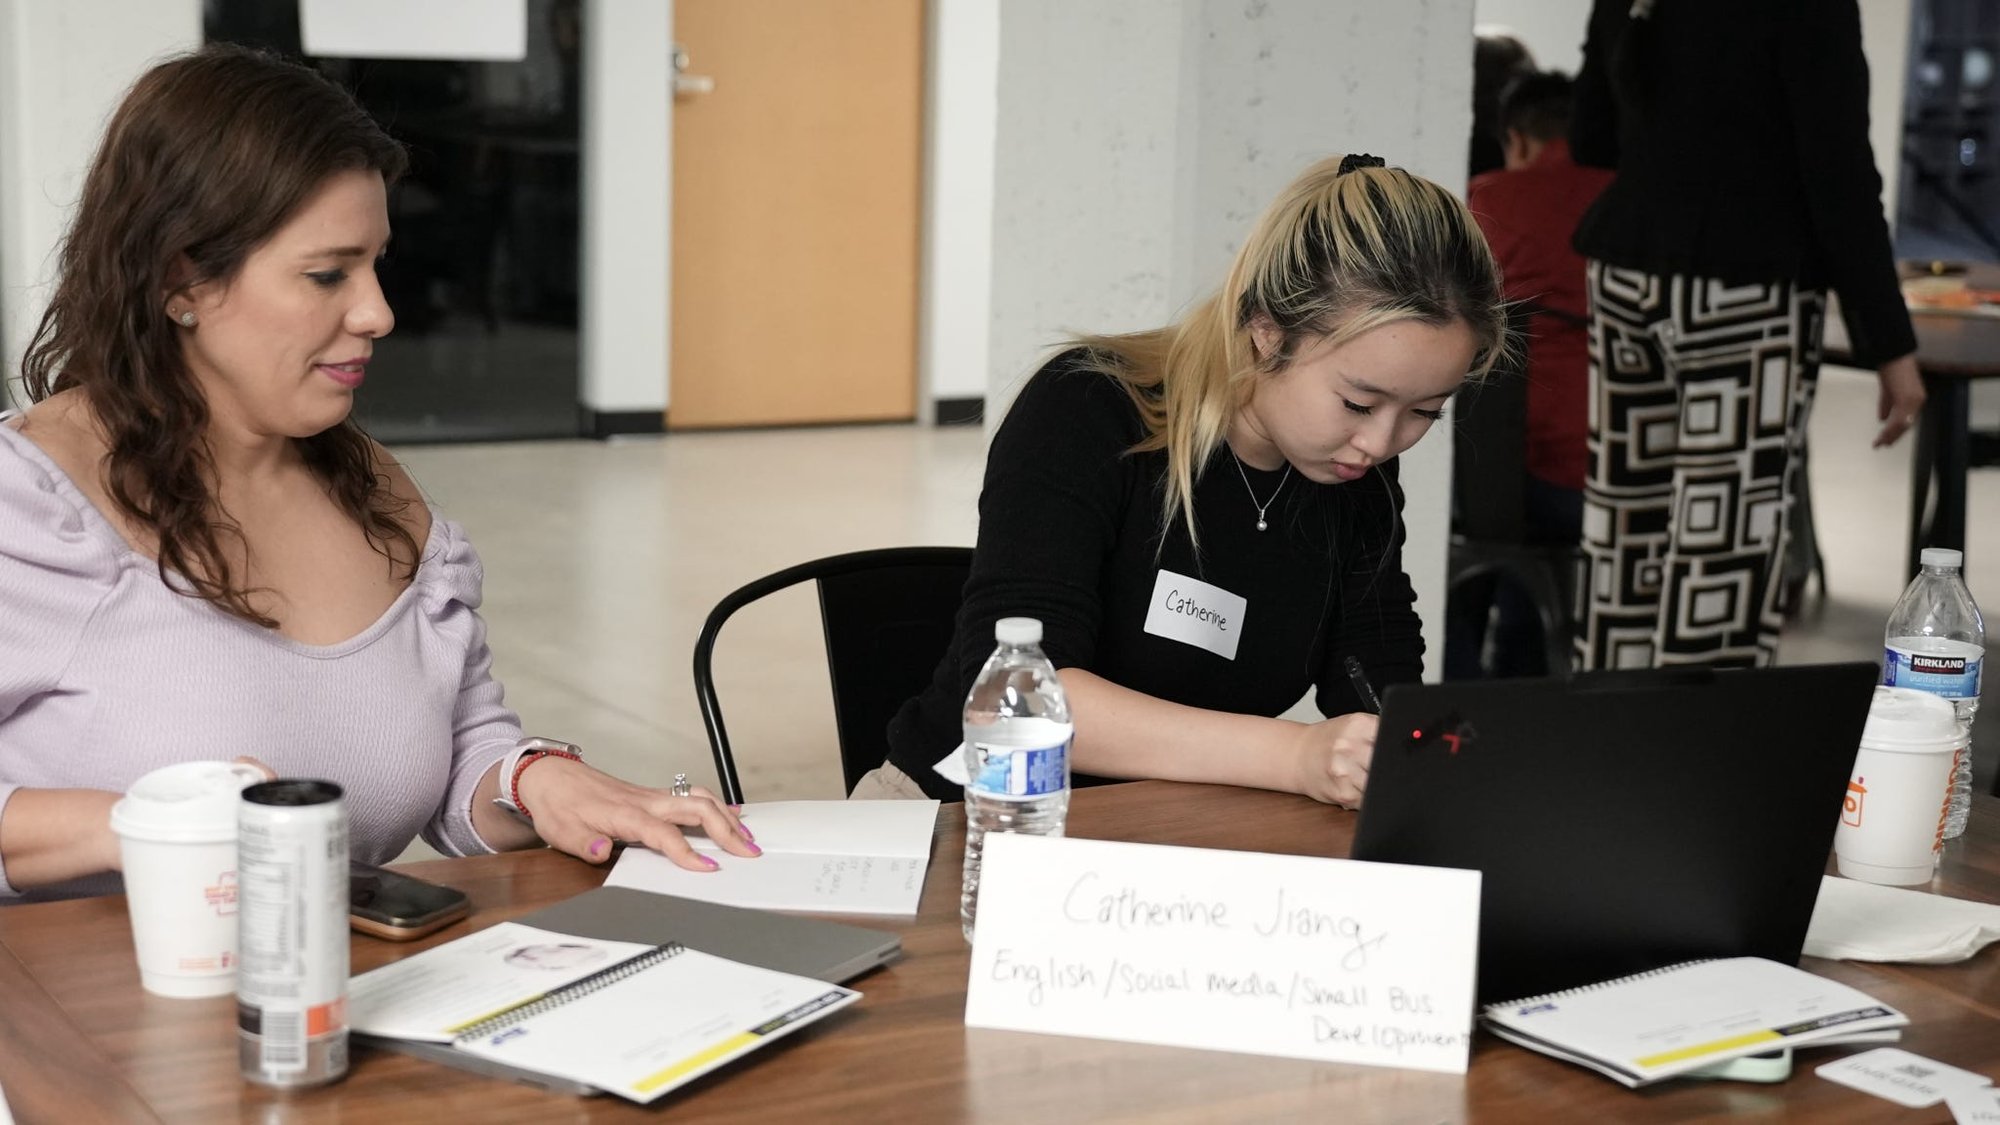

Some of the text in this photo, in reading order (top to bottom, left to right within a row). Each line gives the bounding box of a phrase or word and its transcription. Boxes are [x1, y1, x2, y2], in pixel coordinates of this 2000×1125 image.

[1165, 589, 1227, 631] Catherine
[1914, 657, 1964, 669] KIRKLAND
[1062, 870, 1230, 932] Catherine
